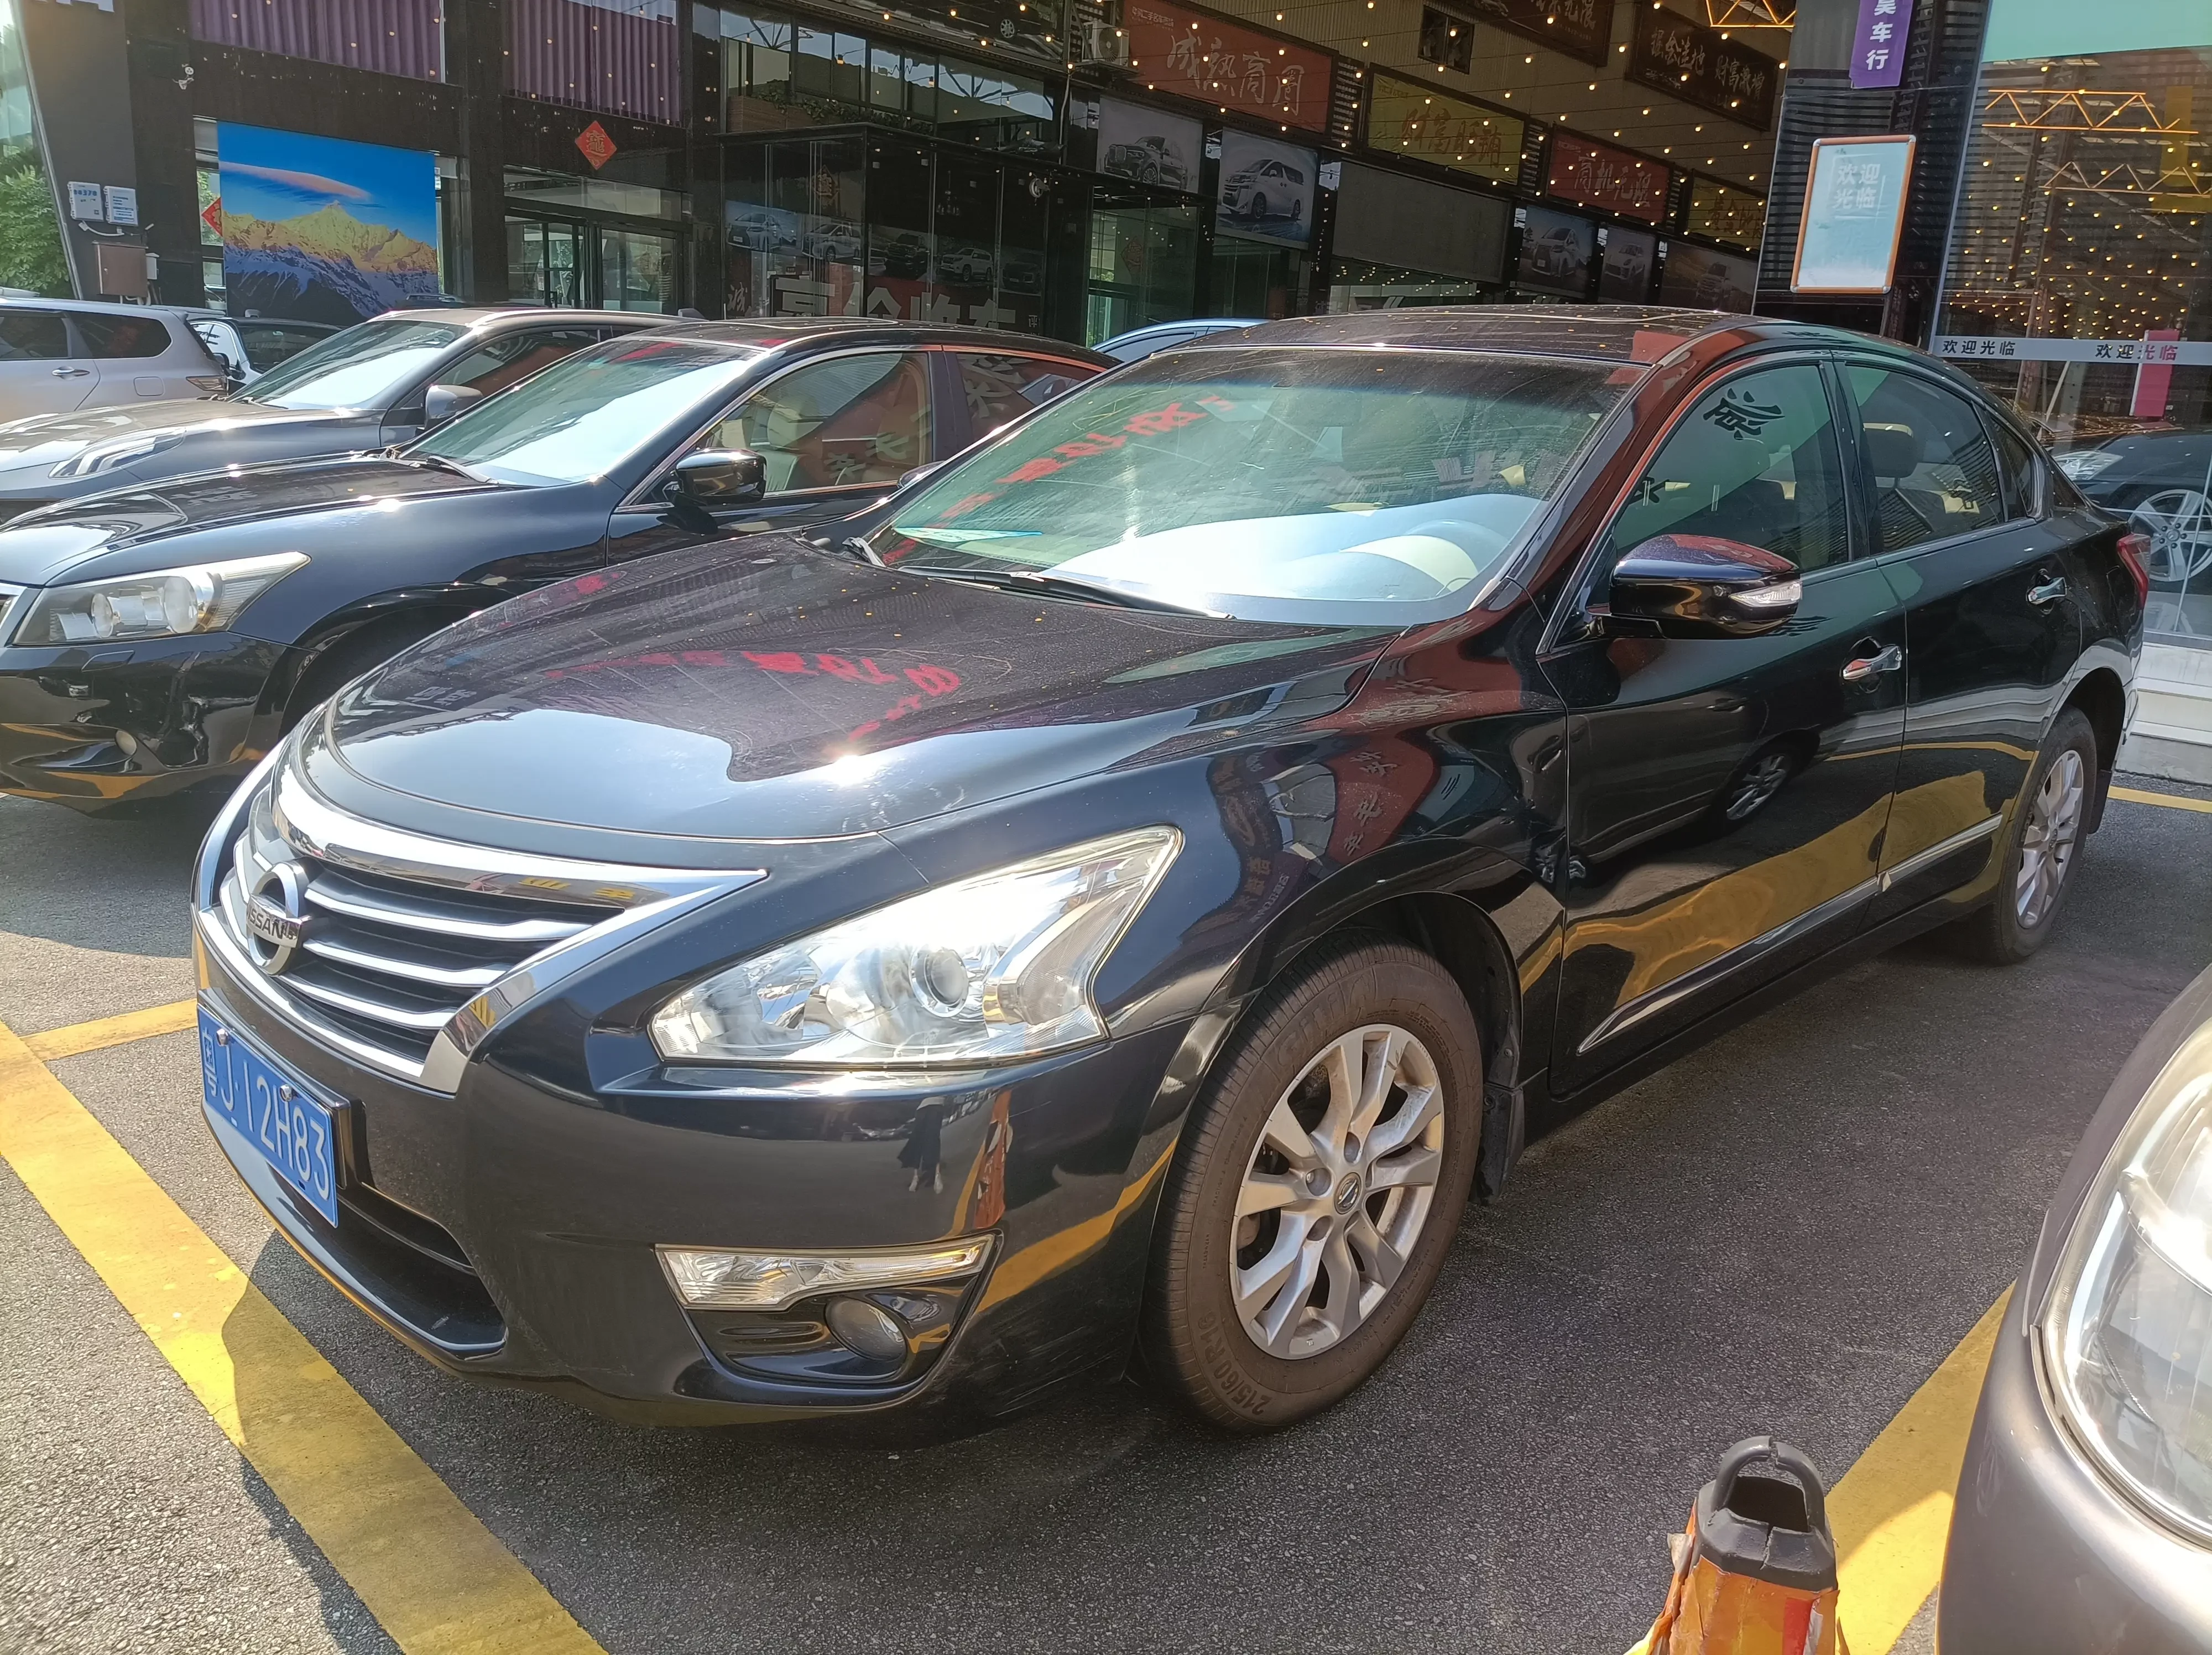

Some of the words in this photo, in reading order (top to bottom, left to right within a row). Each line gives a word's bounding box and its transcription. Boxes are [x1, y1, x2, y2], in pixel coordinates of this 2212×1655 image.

[1167, 28, 1305, 116] 成熟商圈
[1836, 164, 1880, 185] 欢迎
[1833, 188, 1877, 209] 光临
[1942, 340, 2016, 356] 欢迎光临
[2095, 344, 2179, 361] 欢迎光临
[1197, 1309, 1226, 1364] R16
